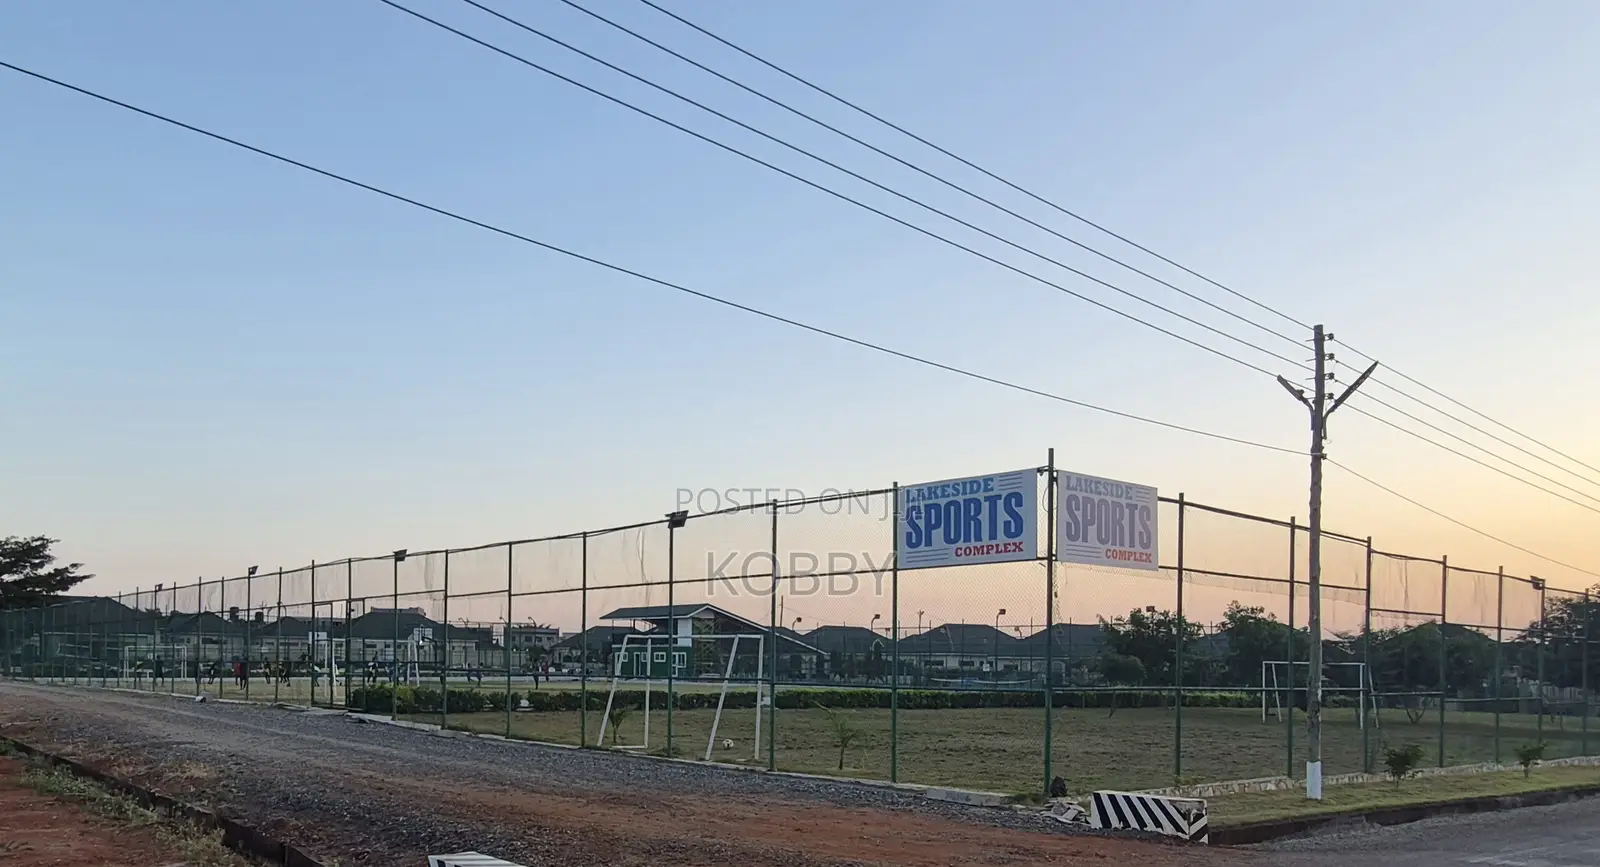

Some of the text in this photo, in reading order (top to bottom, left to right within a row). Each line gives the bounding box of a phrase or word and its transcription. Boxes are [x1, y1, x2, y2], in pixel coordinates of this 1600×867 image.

[906, 477, 994, 503] LAKESIDE
[1066, 475, 1133, 500] LAKESIDE
[905, 491, 1024, 549] SPORTS
[1066, 494, 1151, 550] SPORTS
[954, 541, 1024, 558] COMPLEX
[1105, 548, 1152, 563] COMPLEX
